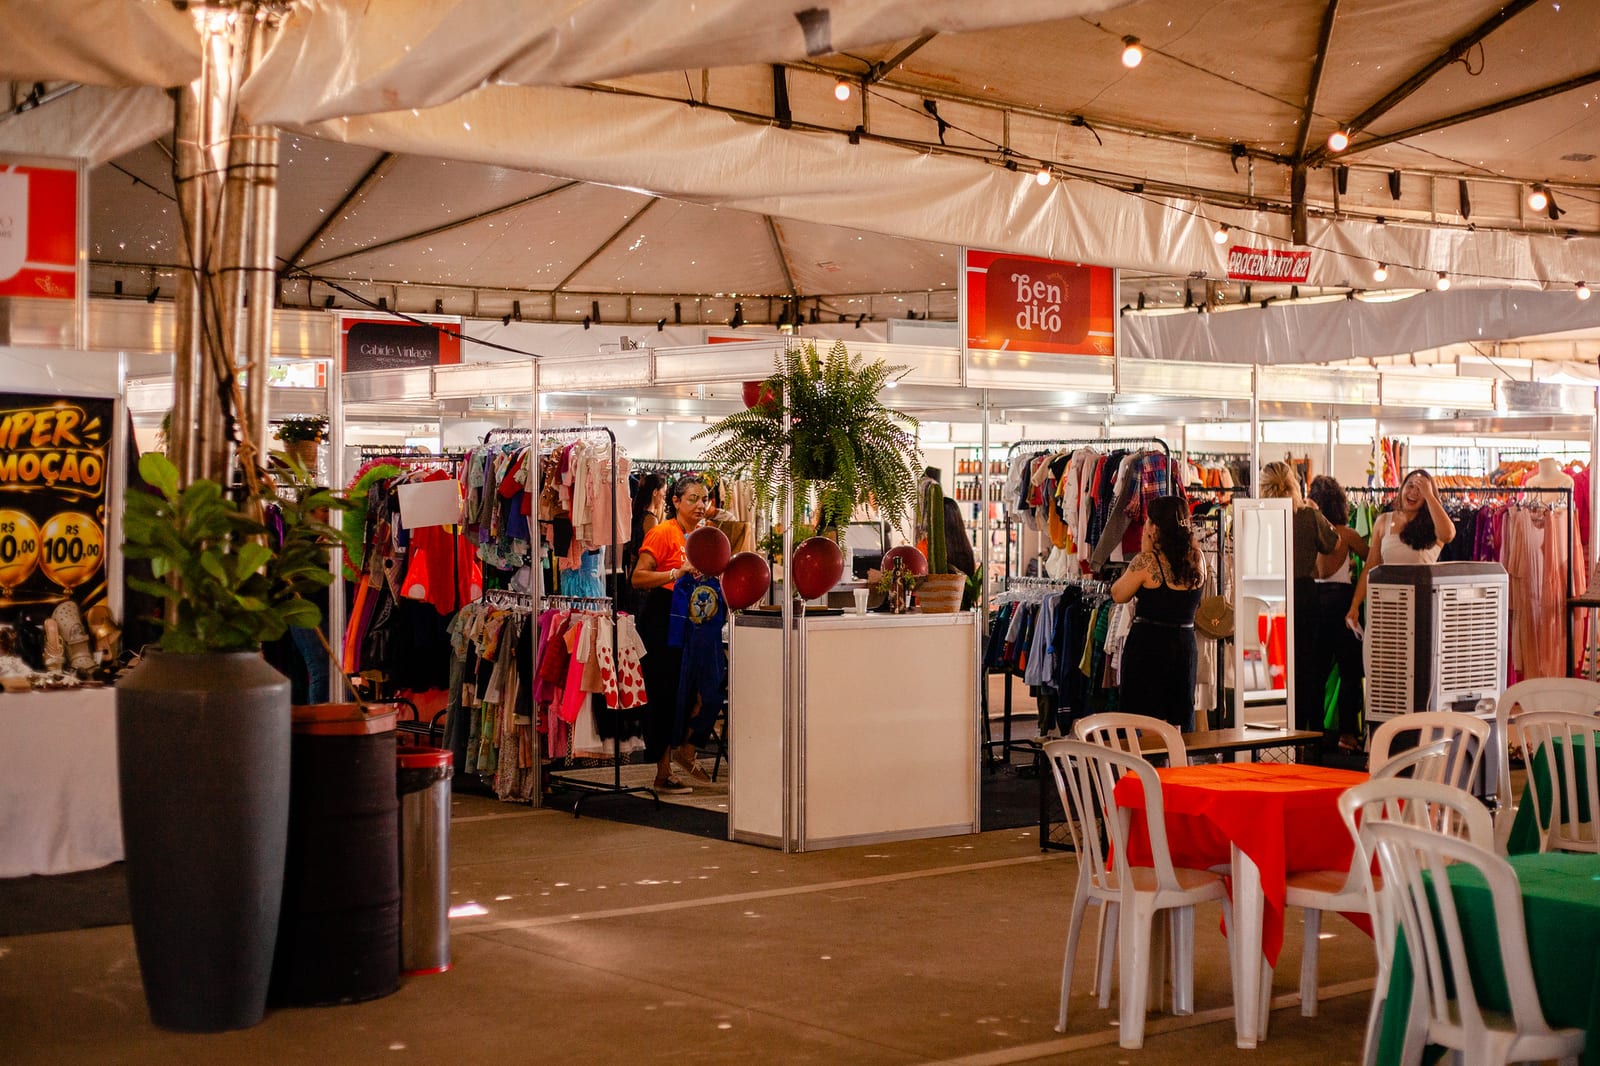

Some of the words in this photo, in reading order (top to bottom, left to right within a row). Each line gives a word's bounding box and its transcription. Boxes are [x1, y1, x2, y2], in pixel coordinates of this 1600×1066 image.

[361, 343, 395, 356] Cabide
[396, 345, 432, 360] Vintage
[65, 525, 79, 536] R$
[43, 537, 100, 564] 100,00
